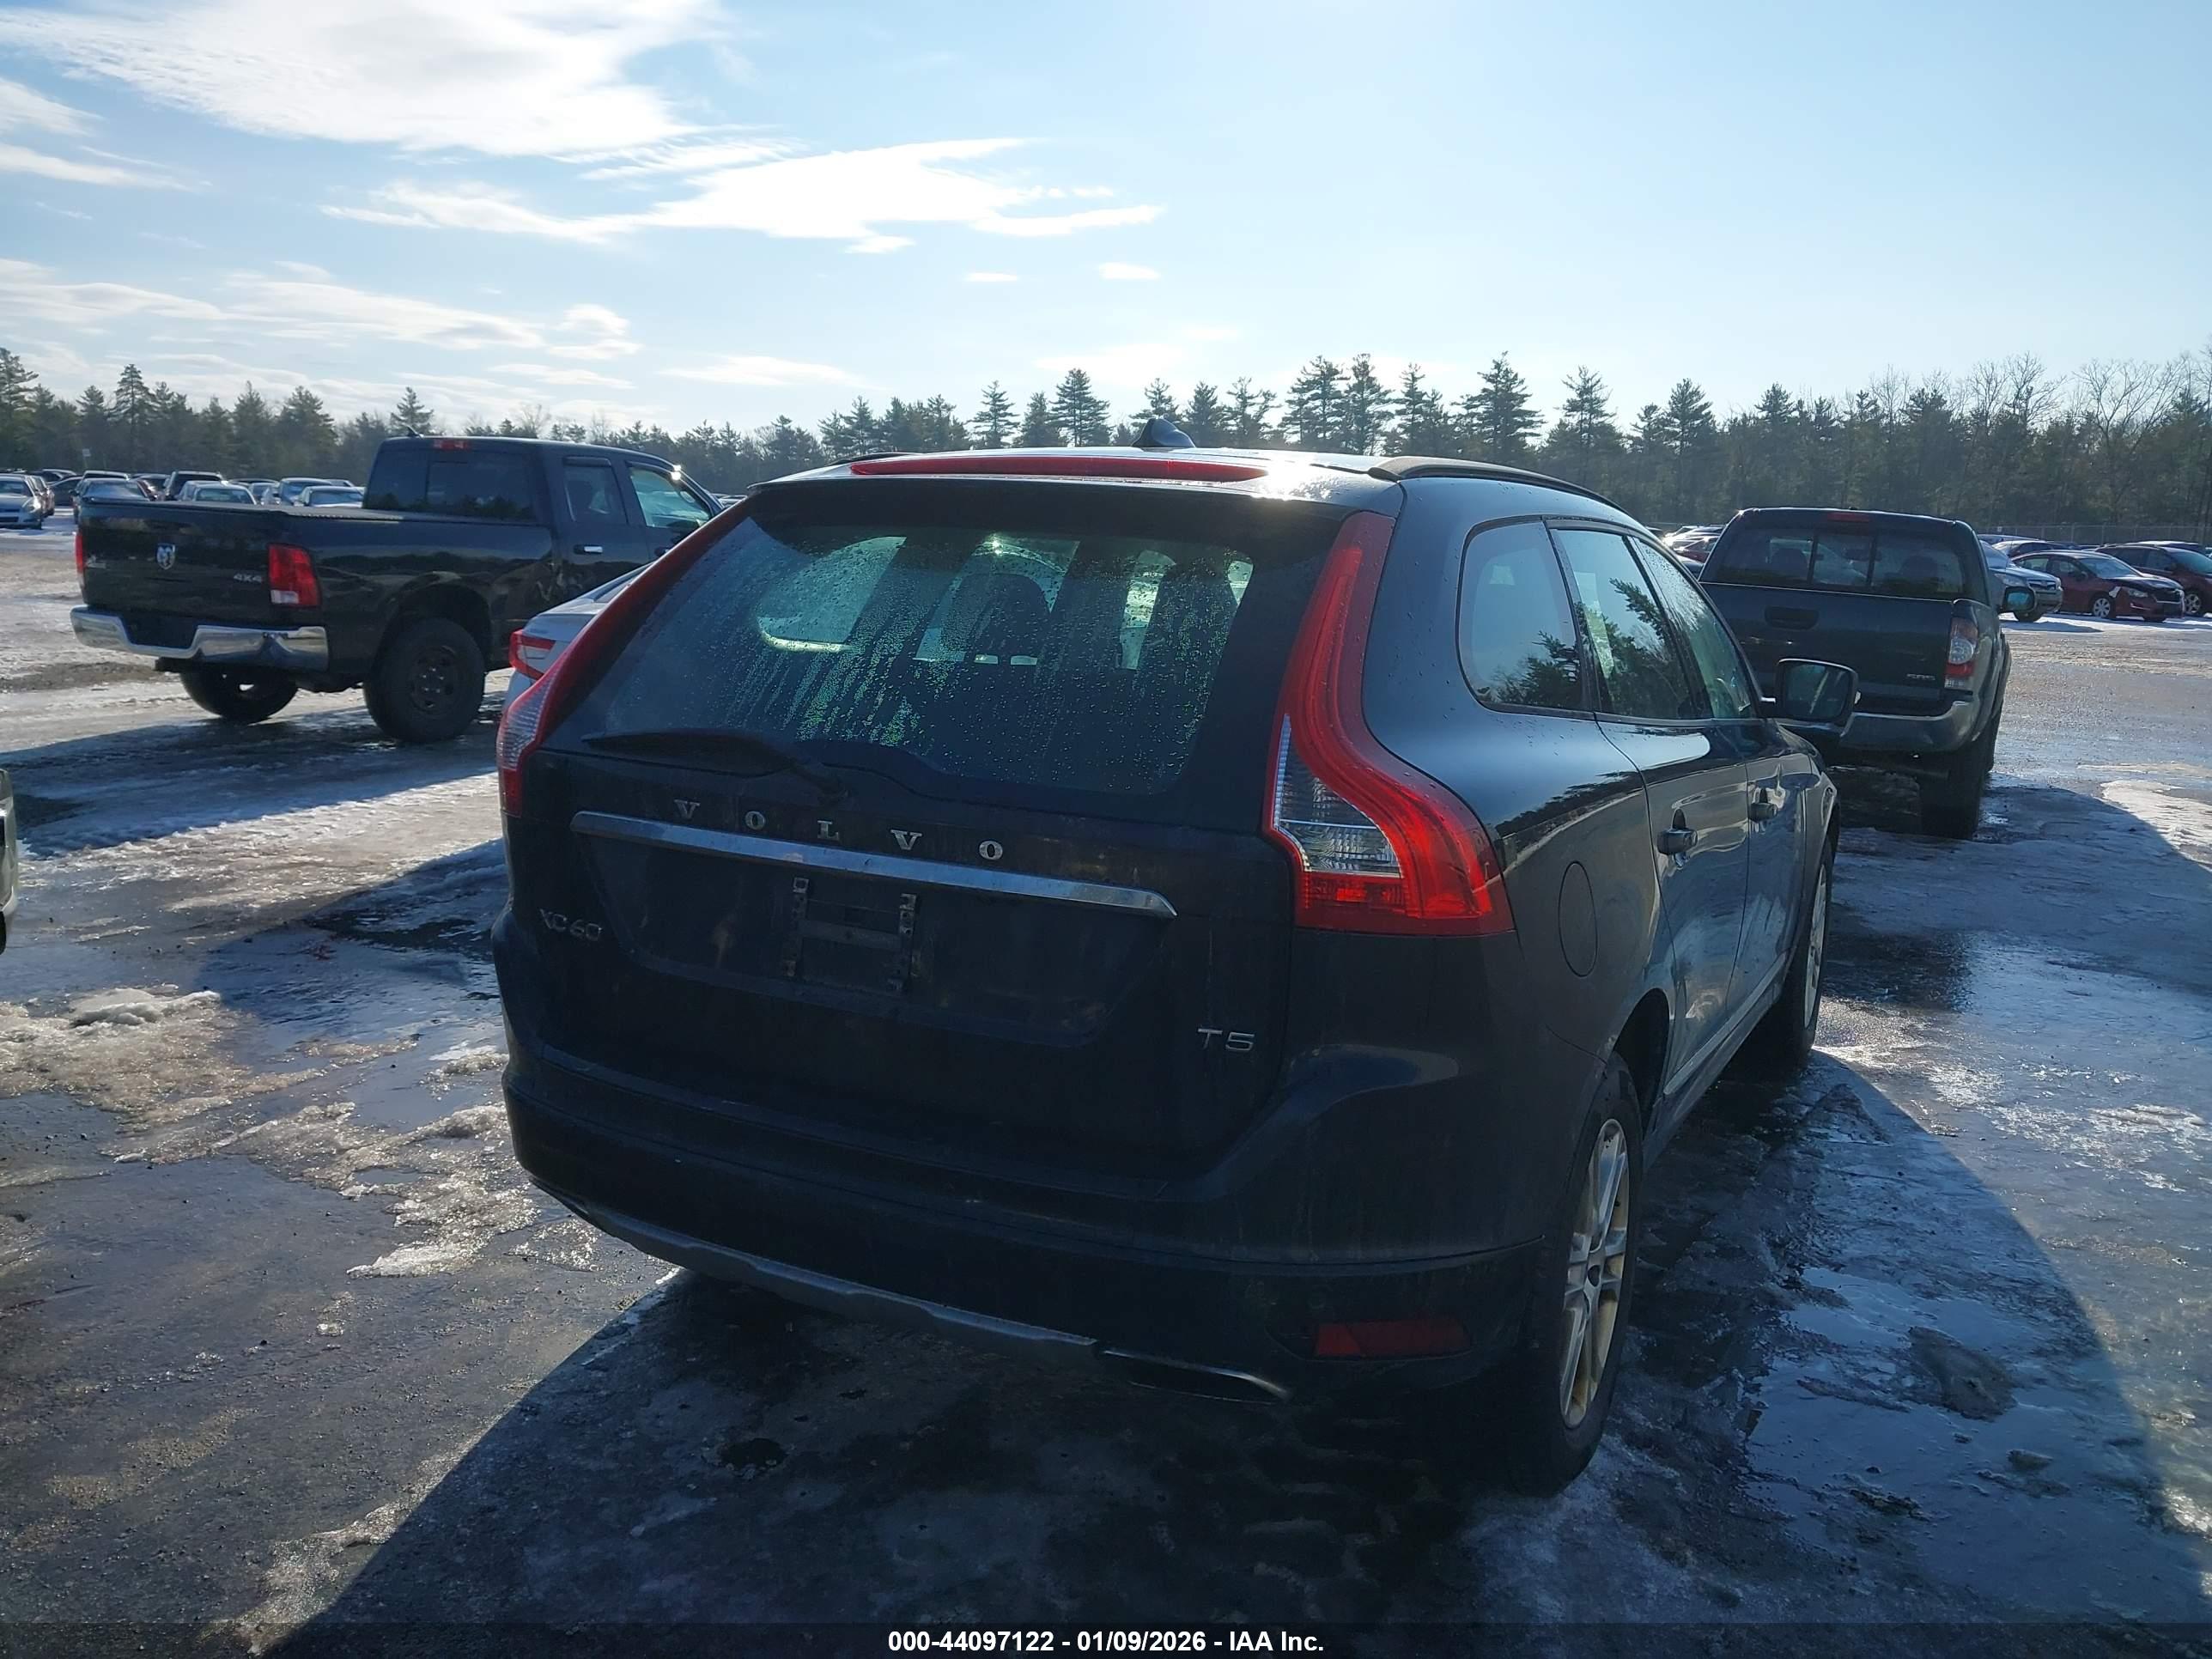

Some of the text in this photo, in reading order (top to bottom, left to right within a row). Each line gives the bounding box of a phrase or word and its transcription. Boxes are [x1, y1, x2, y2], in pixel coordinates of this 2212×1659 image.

[673, 799, 1004, 860] VOLVO
[539, 908, 602, 941] XC60
[1198, 1028, 1255, 1051] T5
